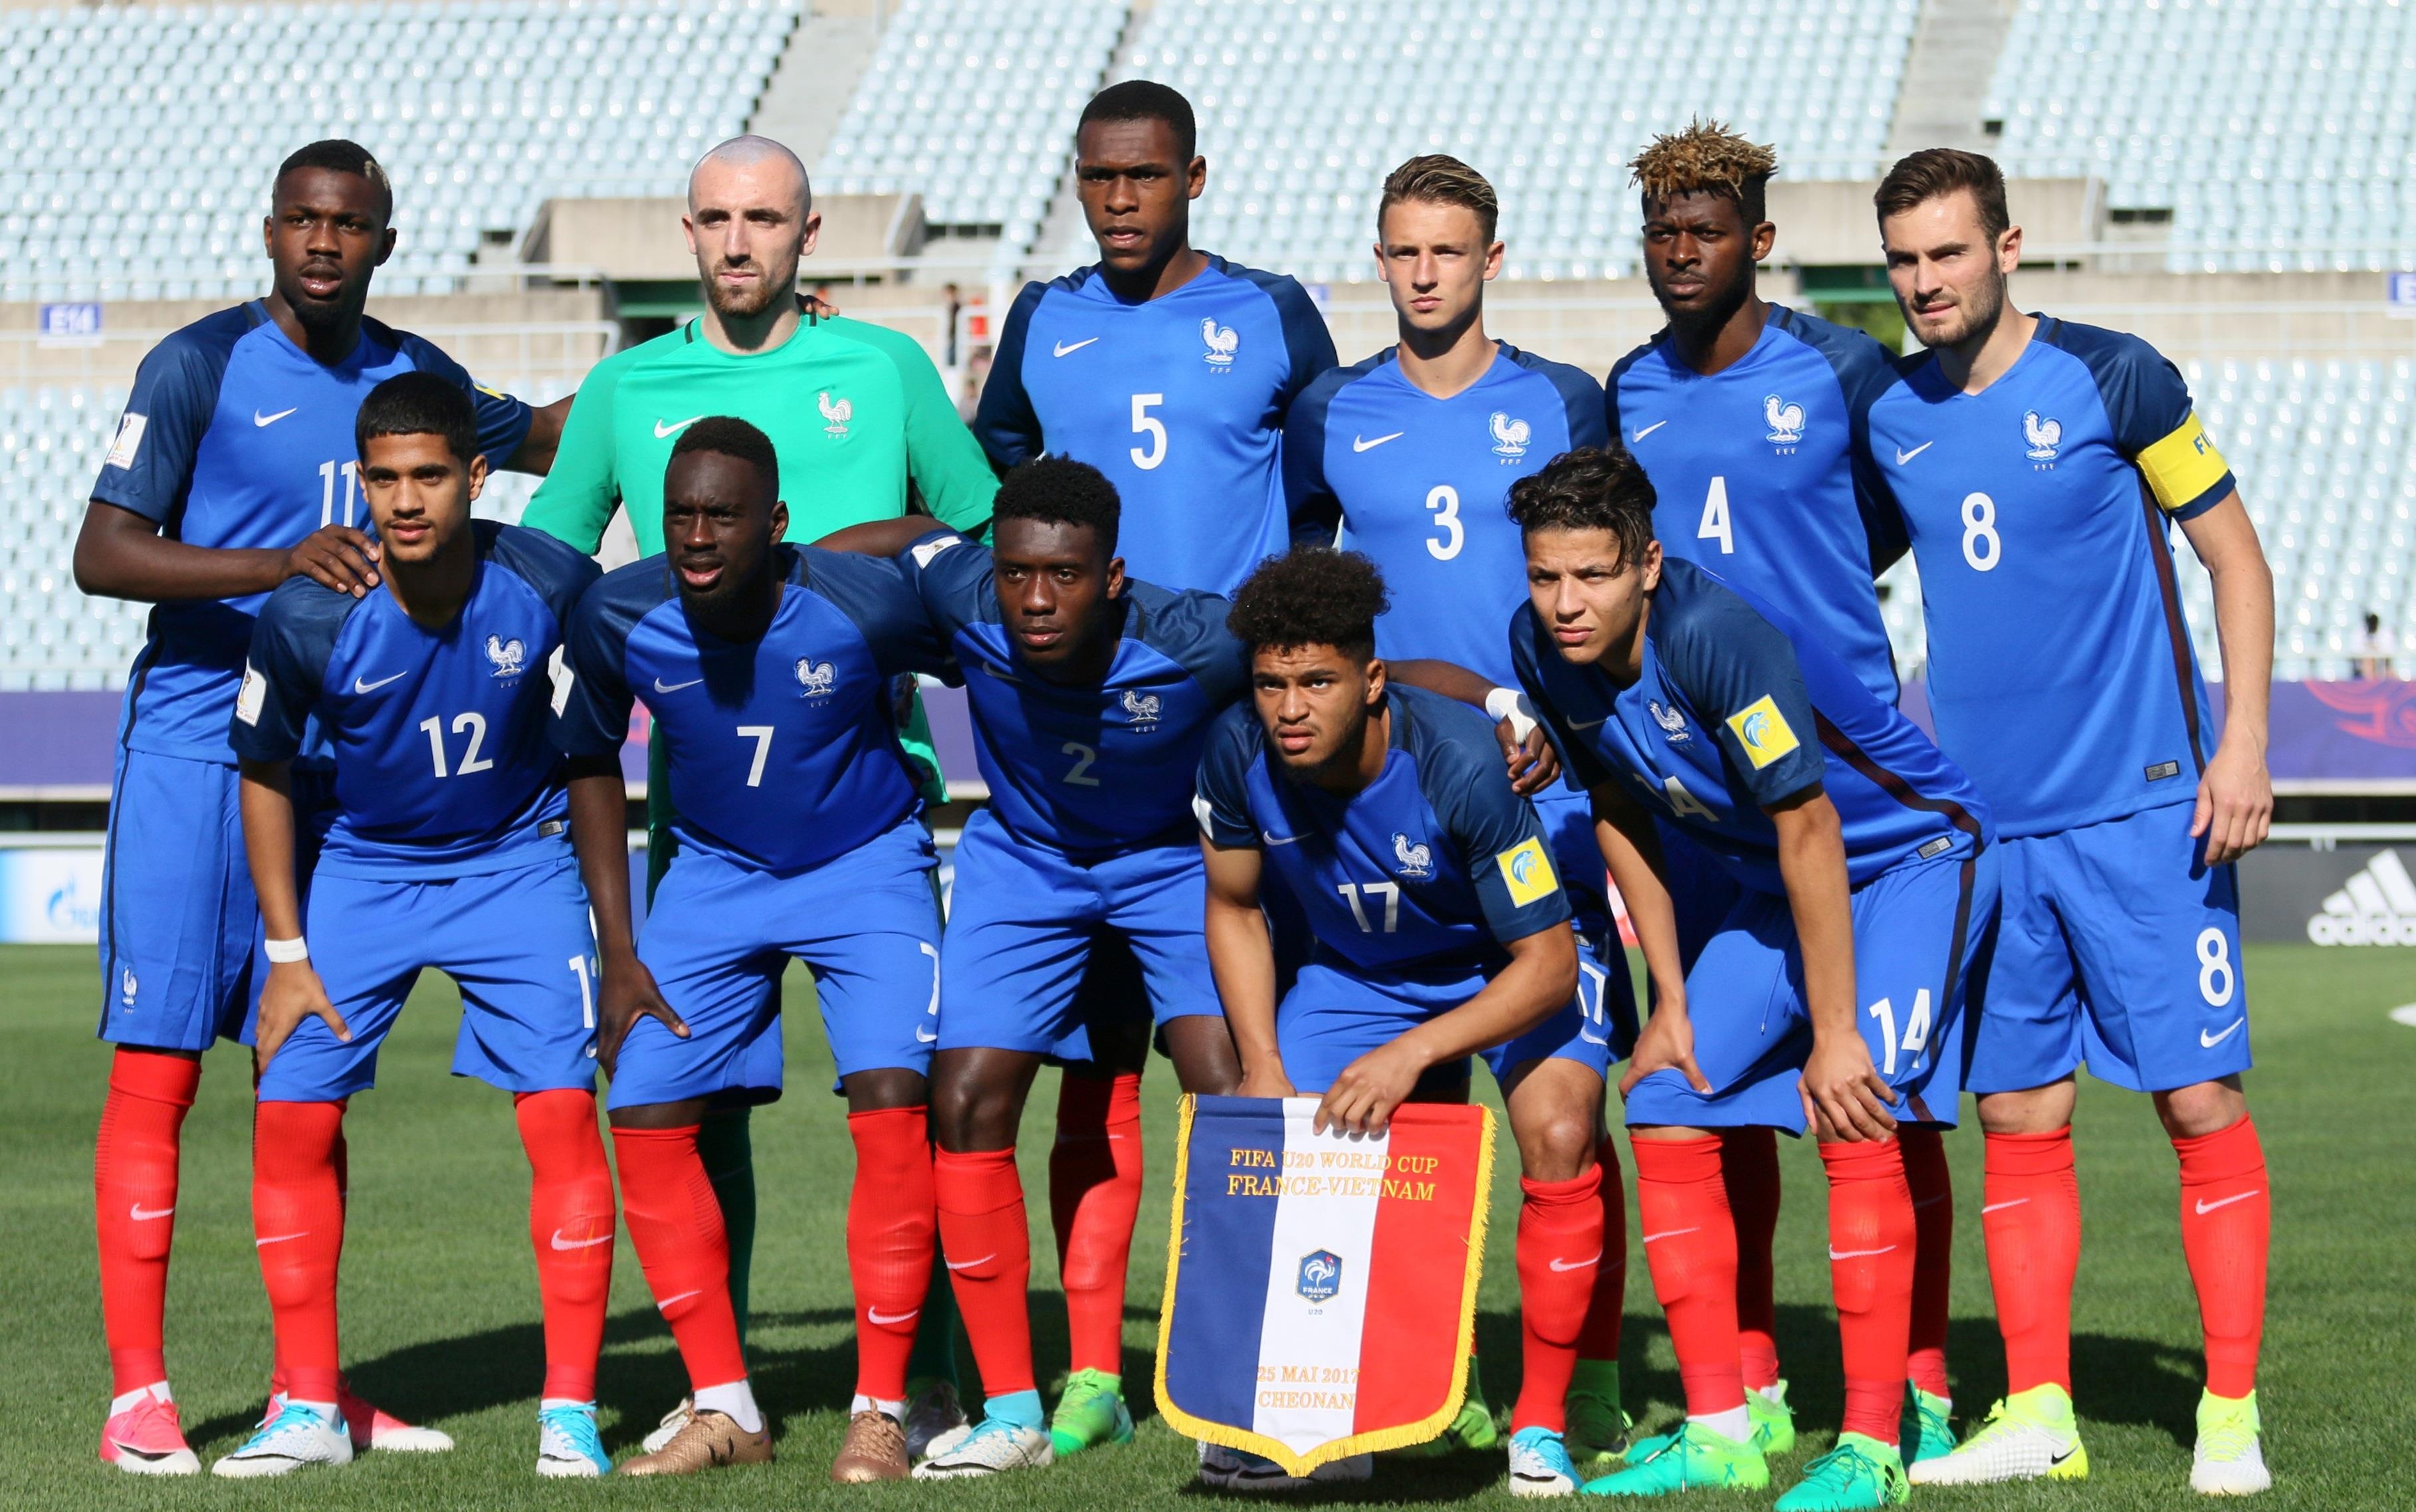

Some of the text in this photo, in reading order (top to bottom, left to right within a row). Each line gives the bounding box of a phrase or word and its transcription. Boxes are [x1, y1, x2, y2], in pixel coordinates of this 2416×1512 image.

[1130, 393, 1168, 471] 5
[319, 460, 357, 530] 11
[1426, 485, 1464, 561] 3
[1697, 476, 1734, 554] 4
[1961, 492, 2001, 572] 8
[420, 712, 493, 778] 12
[736, 726, 774, 787] 7
[1061, 742, 1099, 786] 2
[1632, 773, 1719, 823] 14
[1337, 881, 1399, 932] 17
[2196, 927, 2234, 1007] 8
[1869, 988, 1931, 1075] 14
[1226, 1174, 1436, 1201] FRANCE-VIETNAM
[1230, 1148, 1438, 1174] FIFA U20 WORLD CUP
[1257, 1365, 1361, 1384] 25 MAI 2017
[1258, 1390, 1357, 1410] CHEONAN
